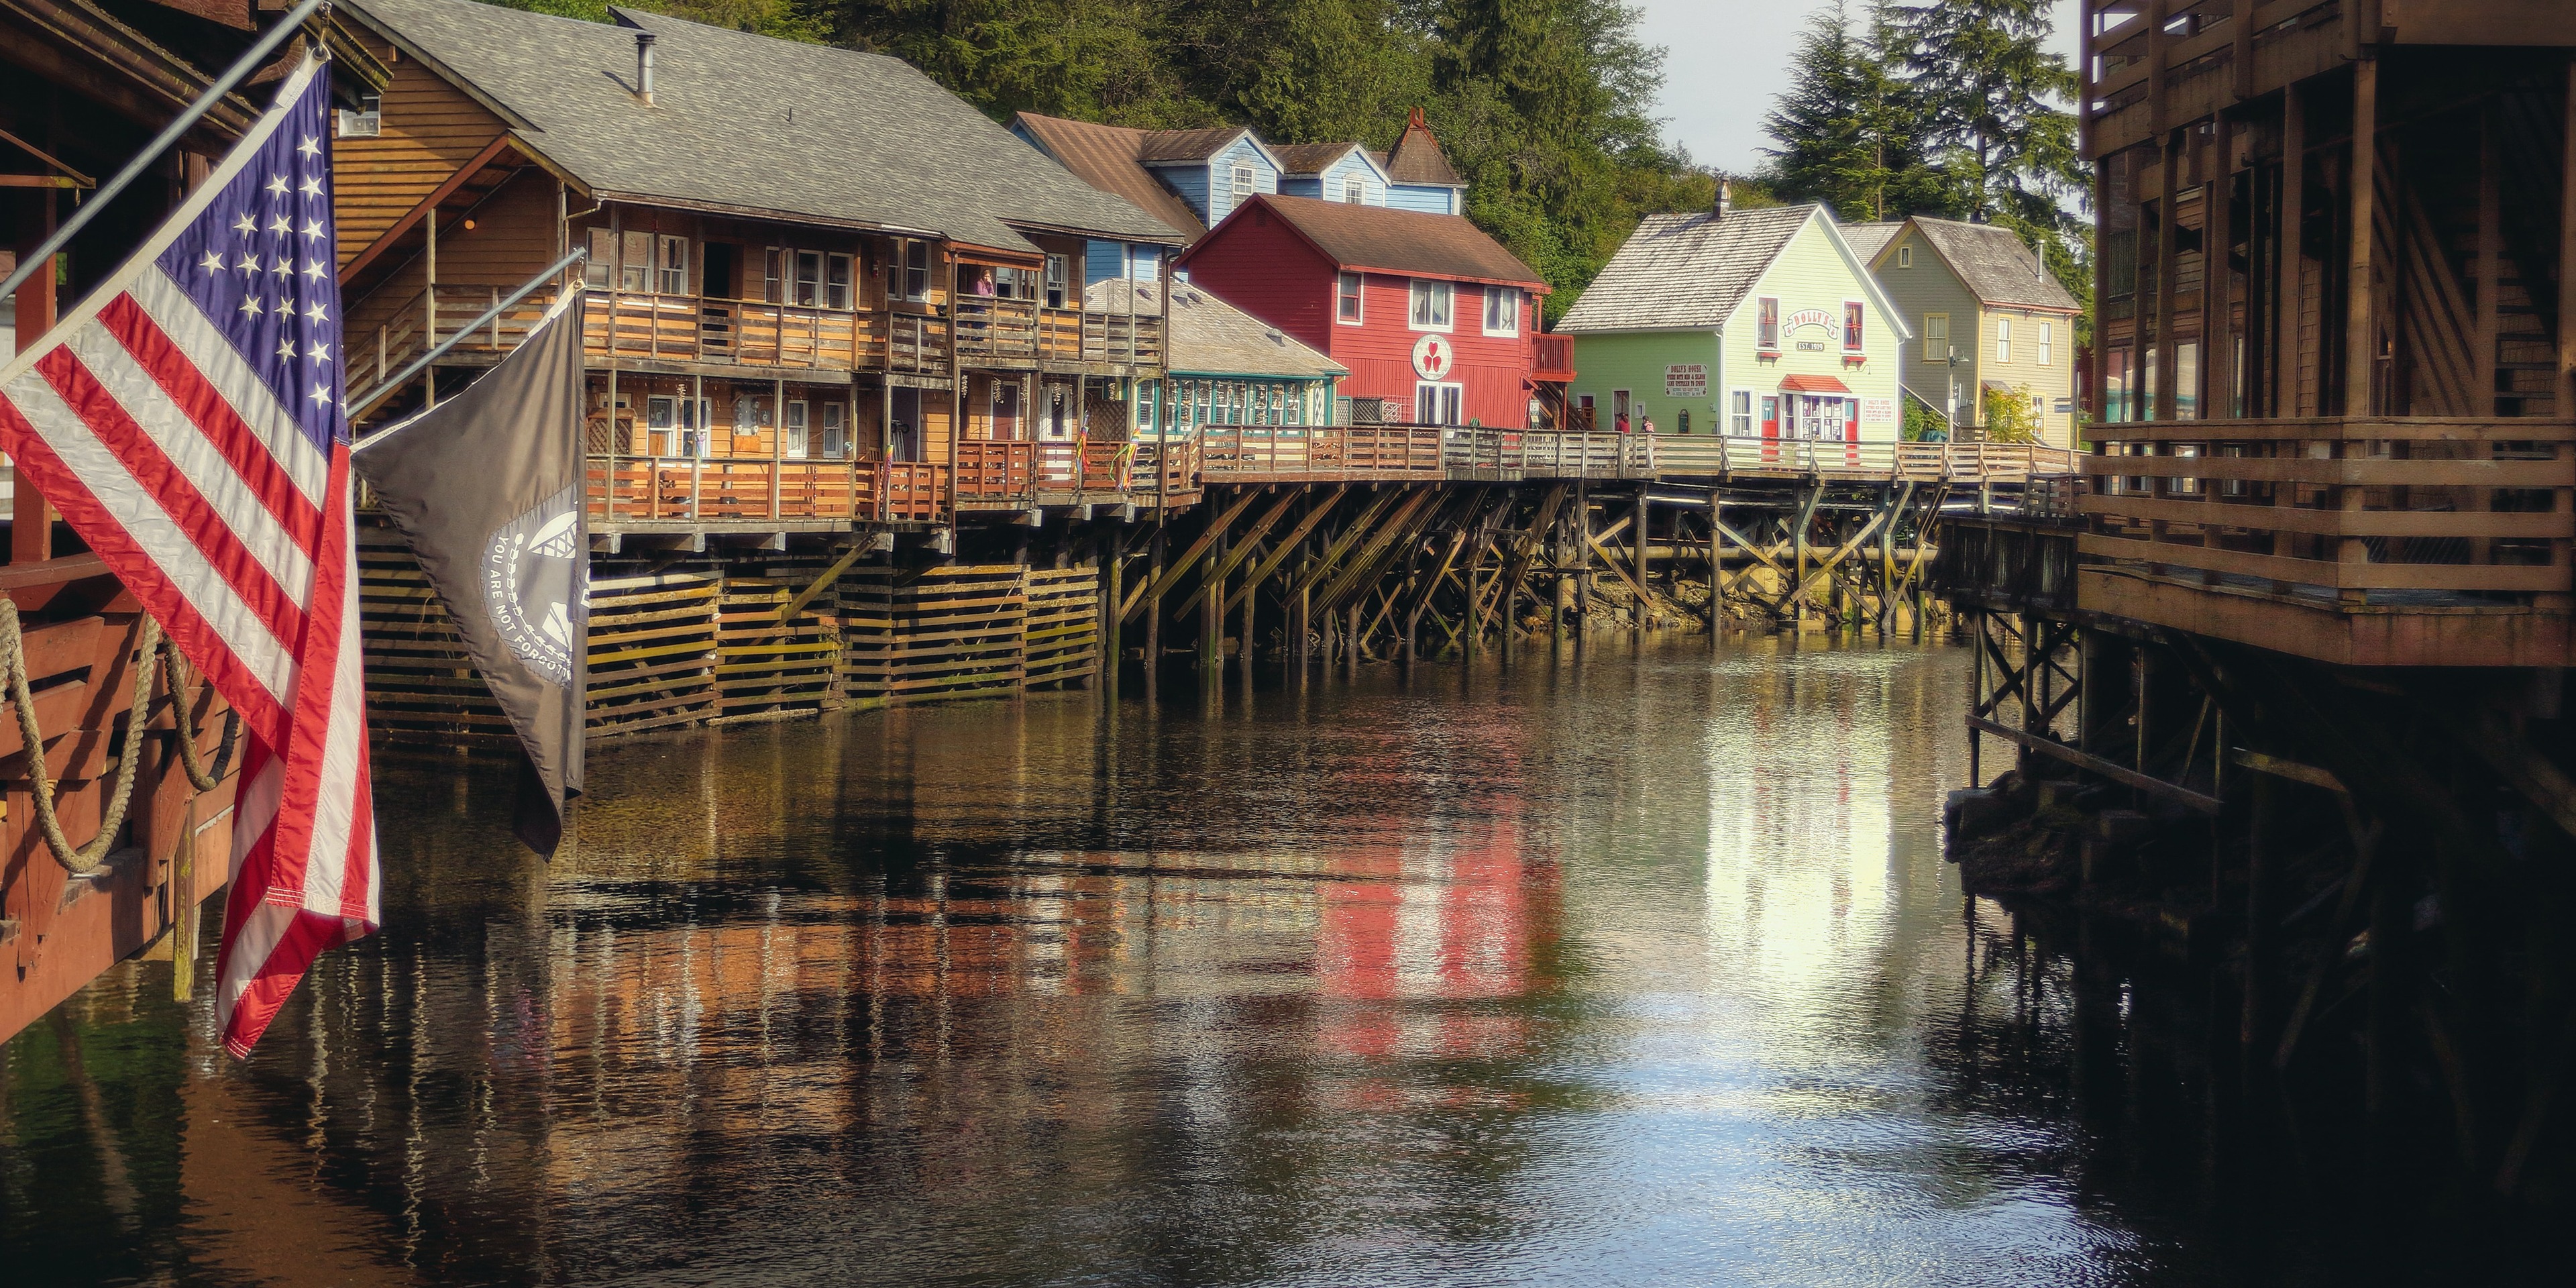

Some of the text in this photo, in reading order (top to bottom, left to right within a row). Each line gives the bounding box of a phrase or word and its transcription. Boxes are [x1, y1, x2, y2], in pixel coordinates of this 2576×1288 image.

[1794, 311, 1829, 326] DOLLY'S
[1811, 343, 1823, 351] 1919
[492, 536, 509, 564] YOU
[490, 570, 503, 599] ARE
[496, 604, 517, 632] NOT
